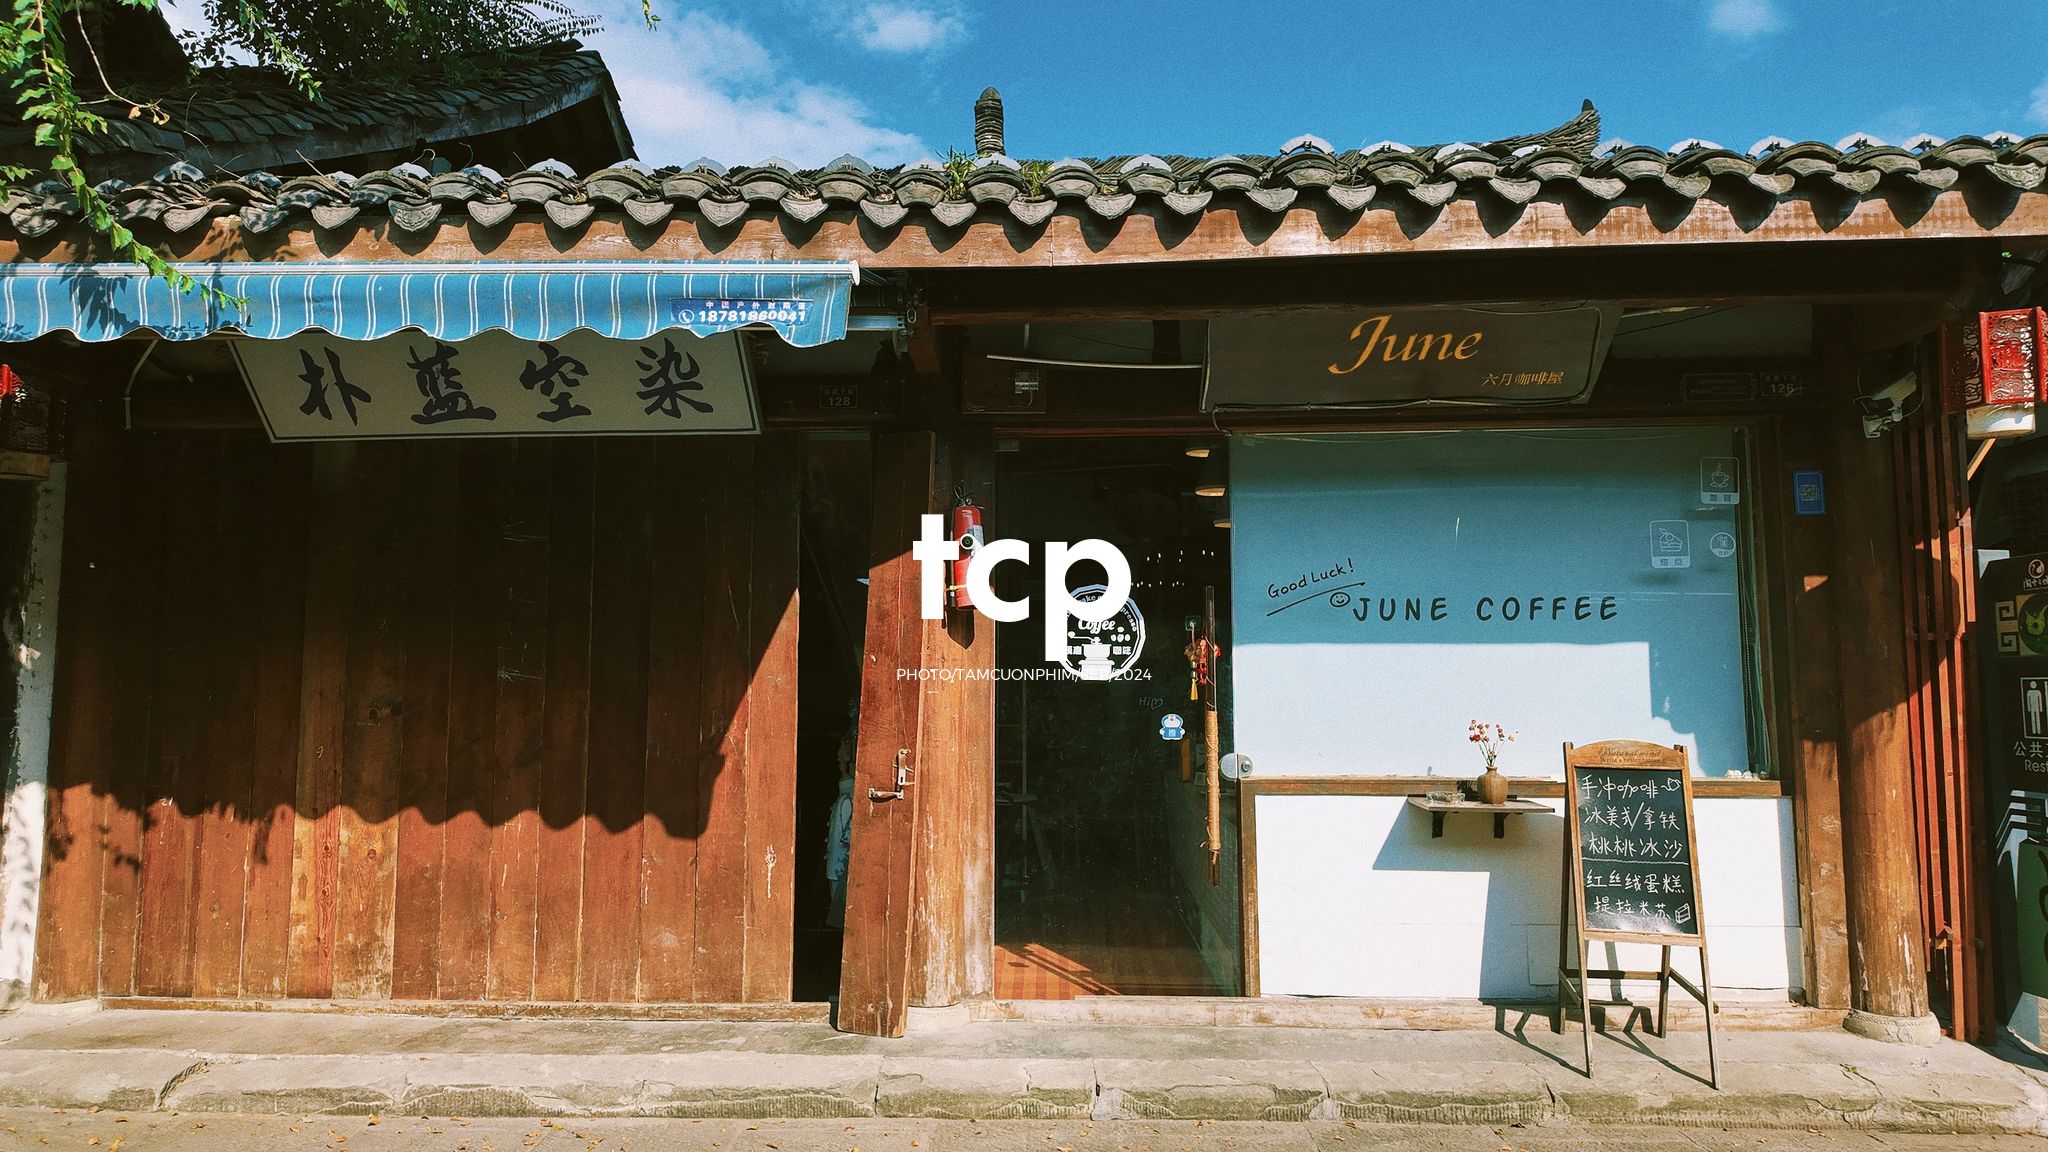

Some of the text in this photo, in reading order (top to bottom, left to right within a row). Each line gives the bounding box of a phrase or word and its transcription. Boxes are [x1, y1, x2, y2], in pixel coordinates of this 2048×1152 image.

[699, 310, 806, 322] 18781860041
[1328, 314, 1483, 374] June
[1482, 371, 1564, 387] 六月咖啡屋
[1769, 383, 1794, 394] 126
[828, 396, 850, 407] 128
[1267, 573, 1309, 599] Good
[1353, 596, 1618, 621] JUNE COFFEE
[2013, 741, 2048, 758] 公共
[1581, 774, 1659, 800] 手冲咖啡
[1588, 831, 1683, 858] 桃桃冰沙
[1586, 869, 1685, 893] 红丝绒蛋糕
[1593, 896, 1671, 920] 提拉米苏
